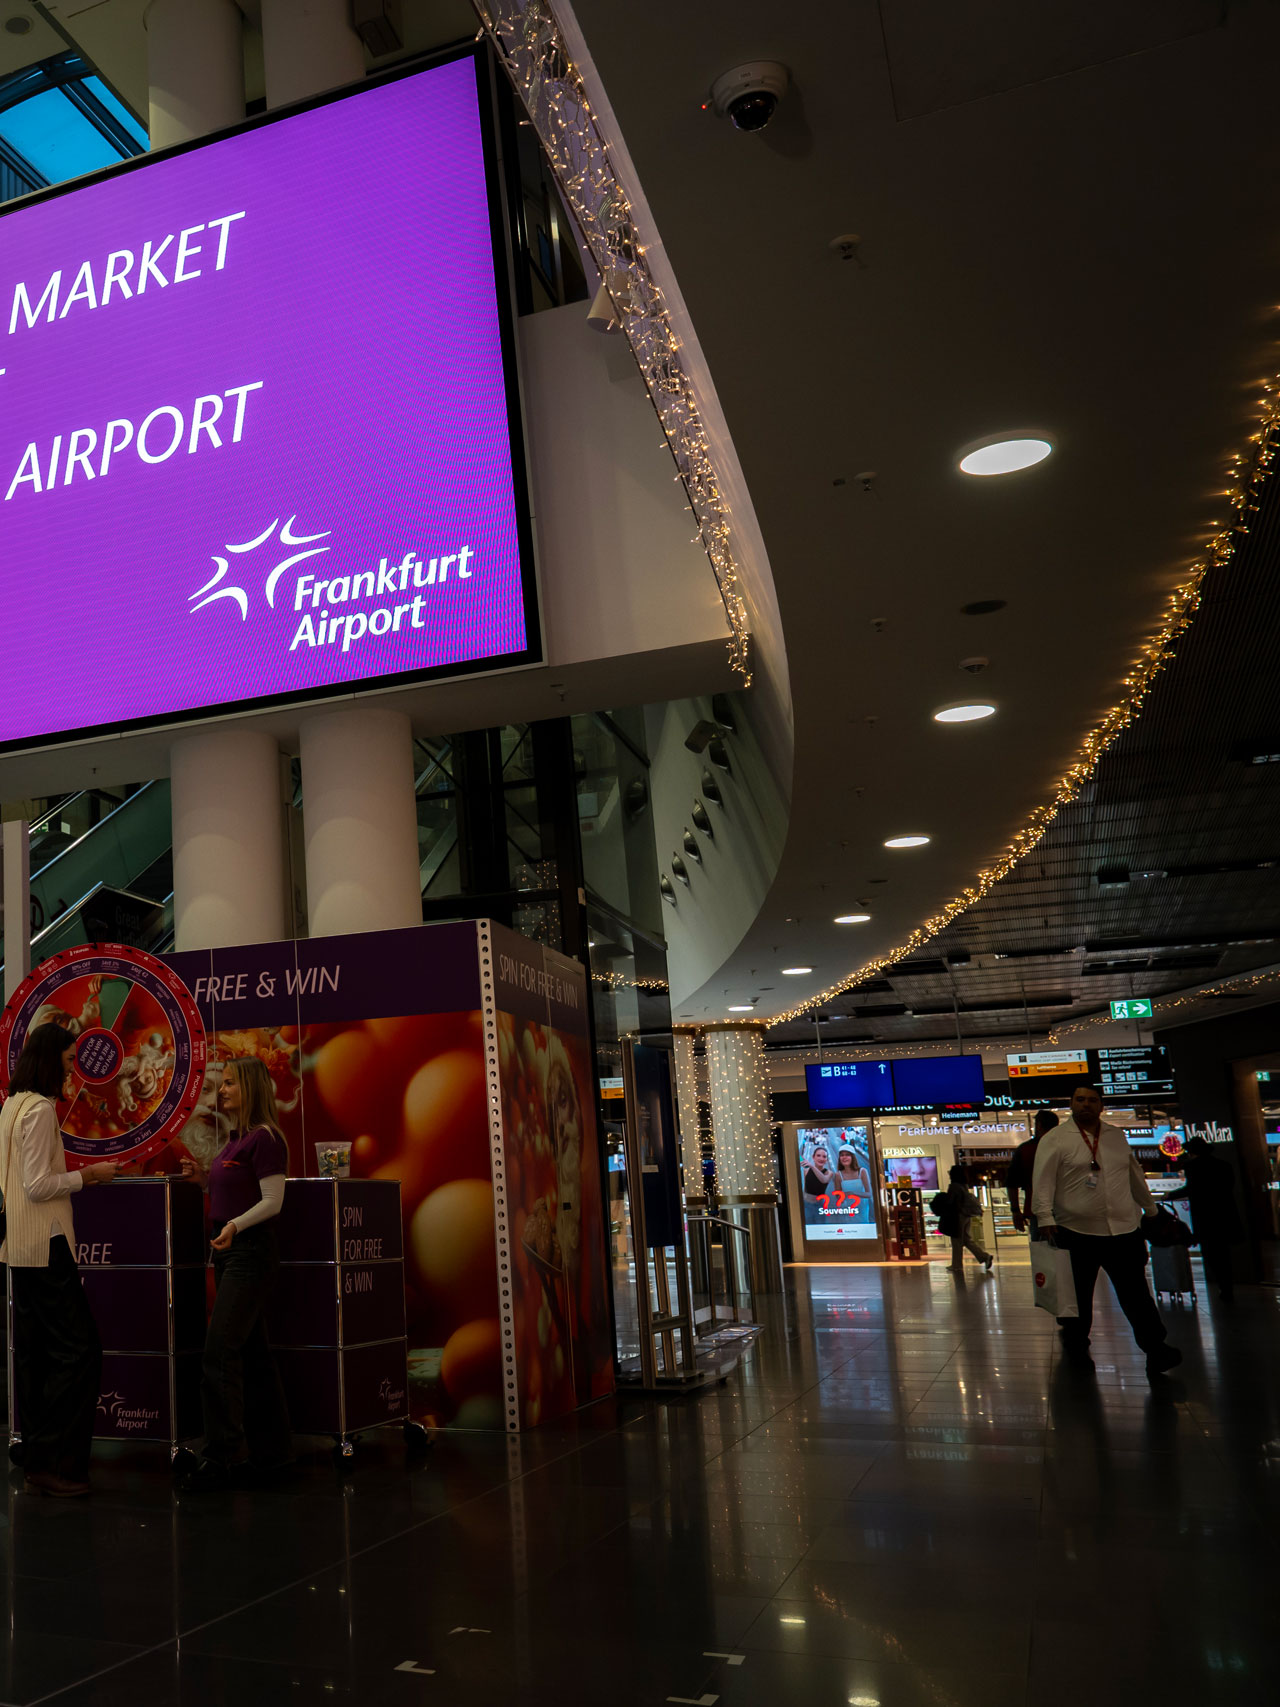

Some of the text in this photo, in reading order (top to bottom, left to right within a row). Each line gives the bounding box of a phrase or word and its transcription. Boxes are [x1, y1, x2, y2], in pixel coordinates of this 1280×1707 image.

[9, 211, 245, 334] MARKET
[5, 381, 263, 501] AIRPORT
[294, 545, 474, 612] Frankfurt
[289, 595, 426, 652] Airport
[194, 965, 340, 1003] FREE & WIN
[500, 954, 578, 1009] SPIN FOR FREE & WIN
[86, 1038, 96, 1051] FOR
[834, 1066, 841, 1076] B
[190, 1075, 200, 1098] PICARD
[941, 1112, 978, 1120] Heinemann
[952, 1126, 960, 1135] &
[883, 1147, 925, 1157] PRADA
[342, 1206, 363, 1228] SPIN
[818, 1206, 860, 1216] Souvenirs
[344, 1238, 382, 1260] FOR FREE
[345, 1272, 373, 1294] & WIN
[117, 1408, 160, 1419] Frankfurt
[116, 1418, 149, 1432] Airport
